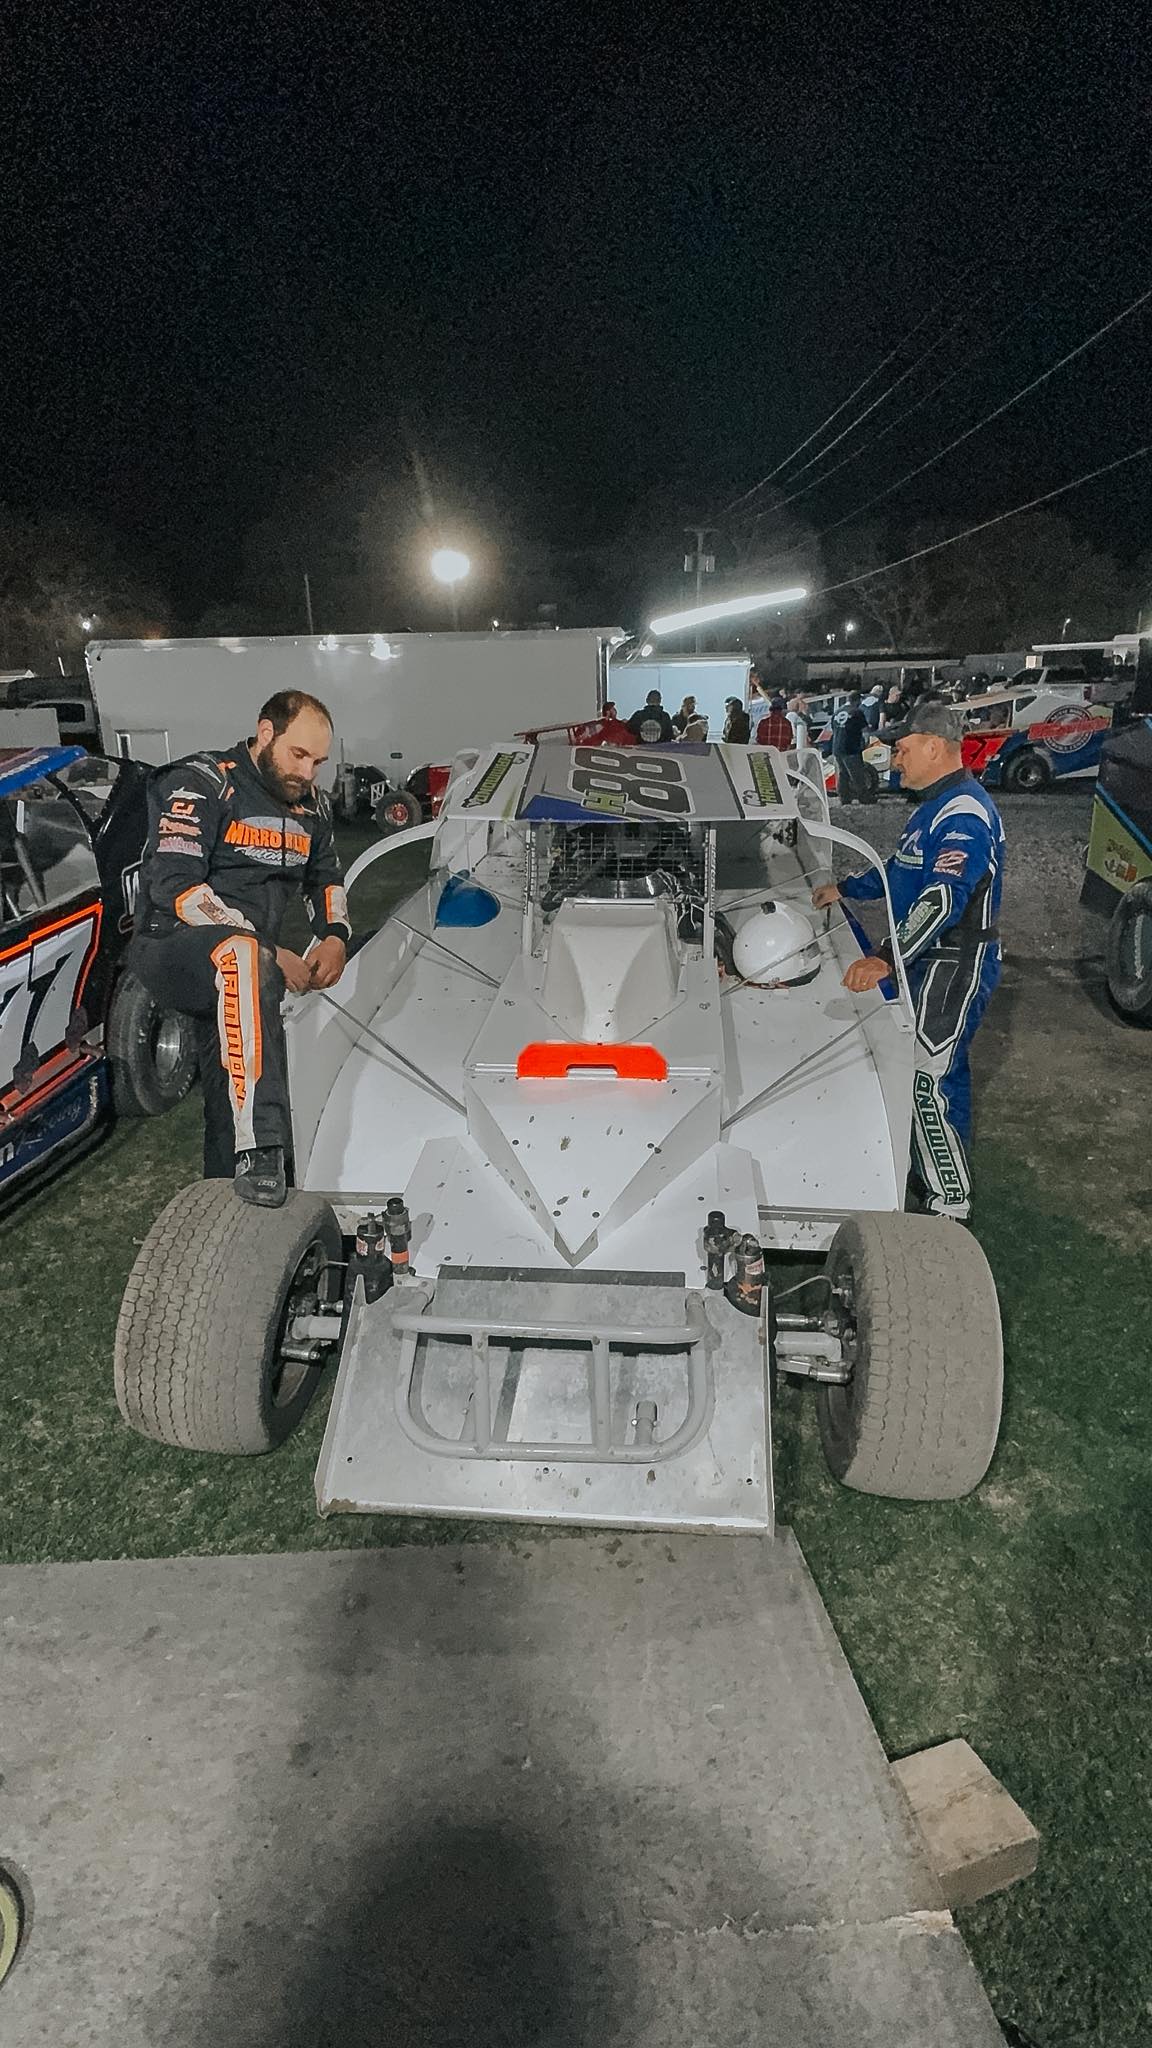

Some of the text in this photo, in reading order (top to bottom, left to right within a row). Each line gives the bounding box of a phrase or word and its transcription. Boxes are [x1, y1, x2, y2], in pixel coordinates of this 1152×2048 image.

[570, 746, 694, 814] 88
[220, 948, 247, 1109] HAMMON
[914, 1071, 964, 1205] HAMMOND
